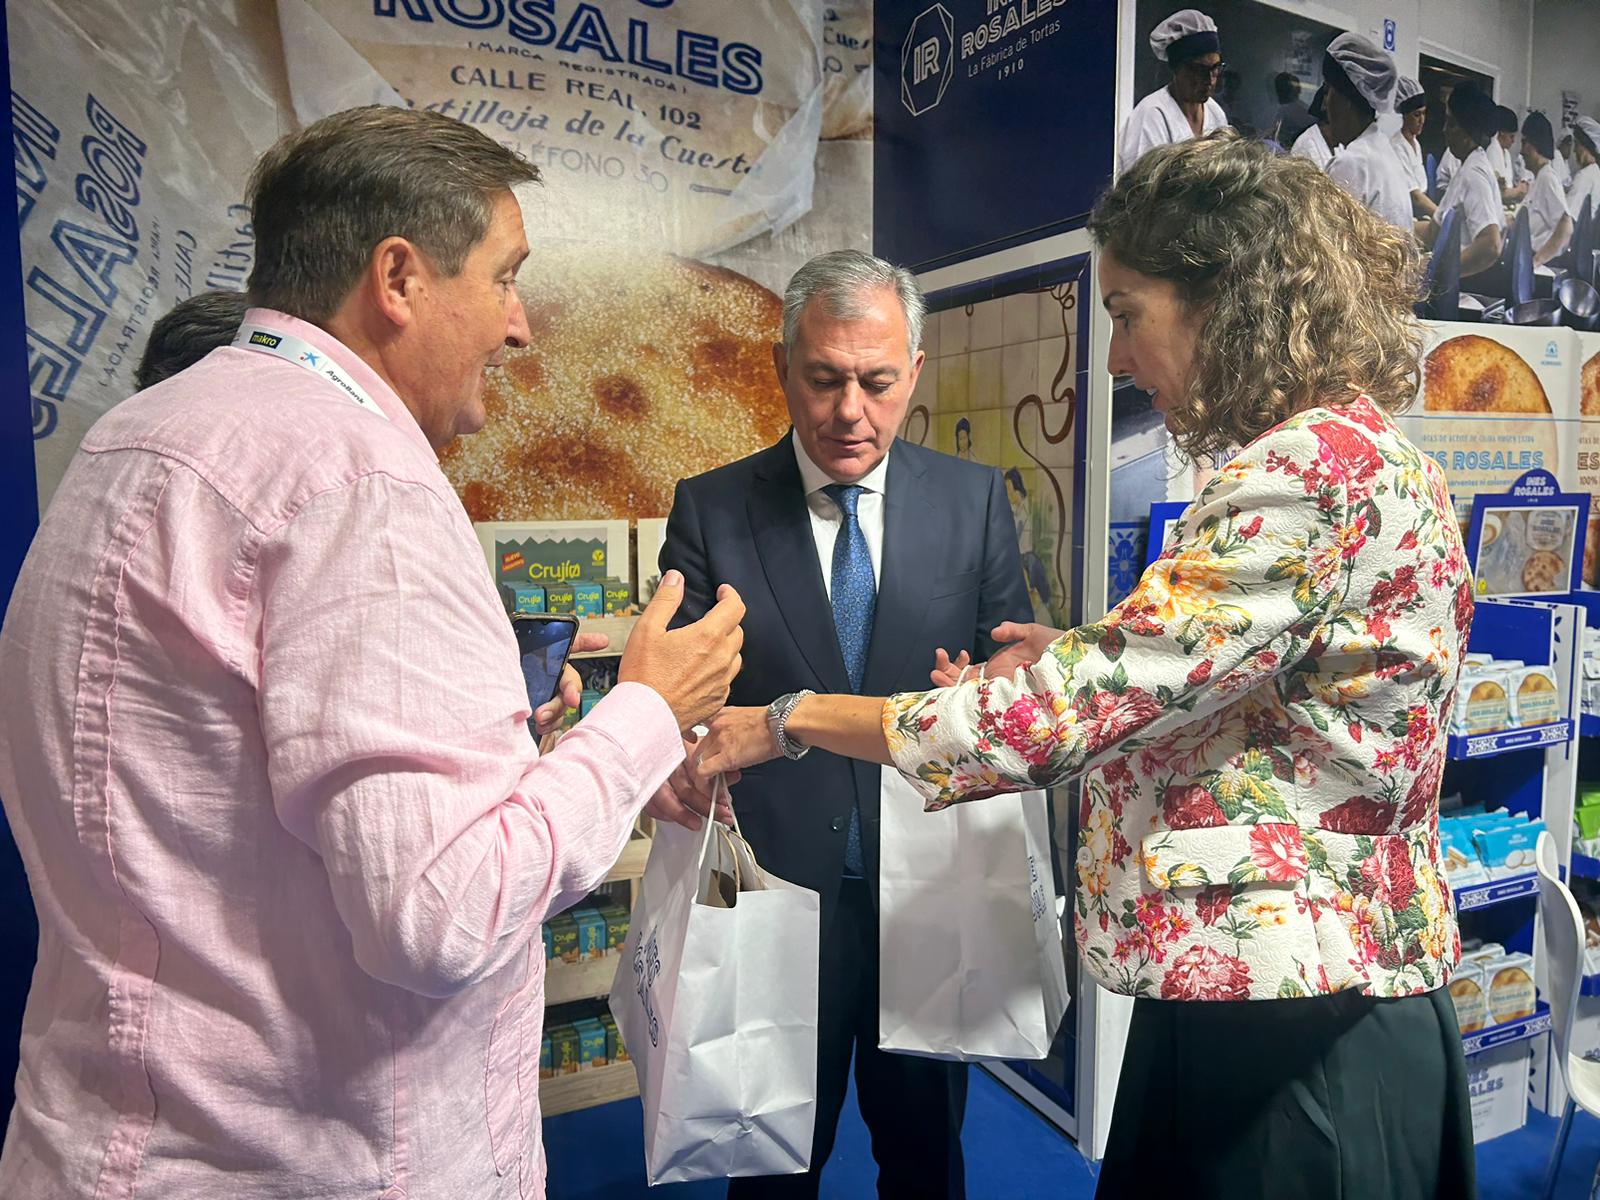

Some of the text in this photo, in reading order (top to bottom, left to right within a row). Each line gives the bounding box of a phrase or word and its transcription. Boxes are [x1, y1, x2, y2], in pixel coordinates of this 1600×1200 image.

[914, 37, 939, 85] IR
[968, 19, 1061, 78] La Fábrica de Tortas
[998, 58, 1024, 80] 1910
[451, 65, 702, 130] CALLE REAL, 102
[564, 109, 606, 137] de
[613, 119, 646, 147] la
[251, 333, 277, 347] makro
[325, 369, 365, 405] AgroBank
[1452, 450, 1544, 471] ROSALES
[1513, 486, 1555, 497] ROSALES
